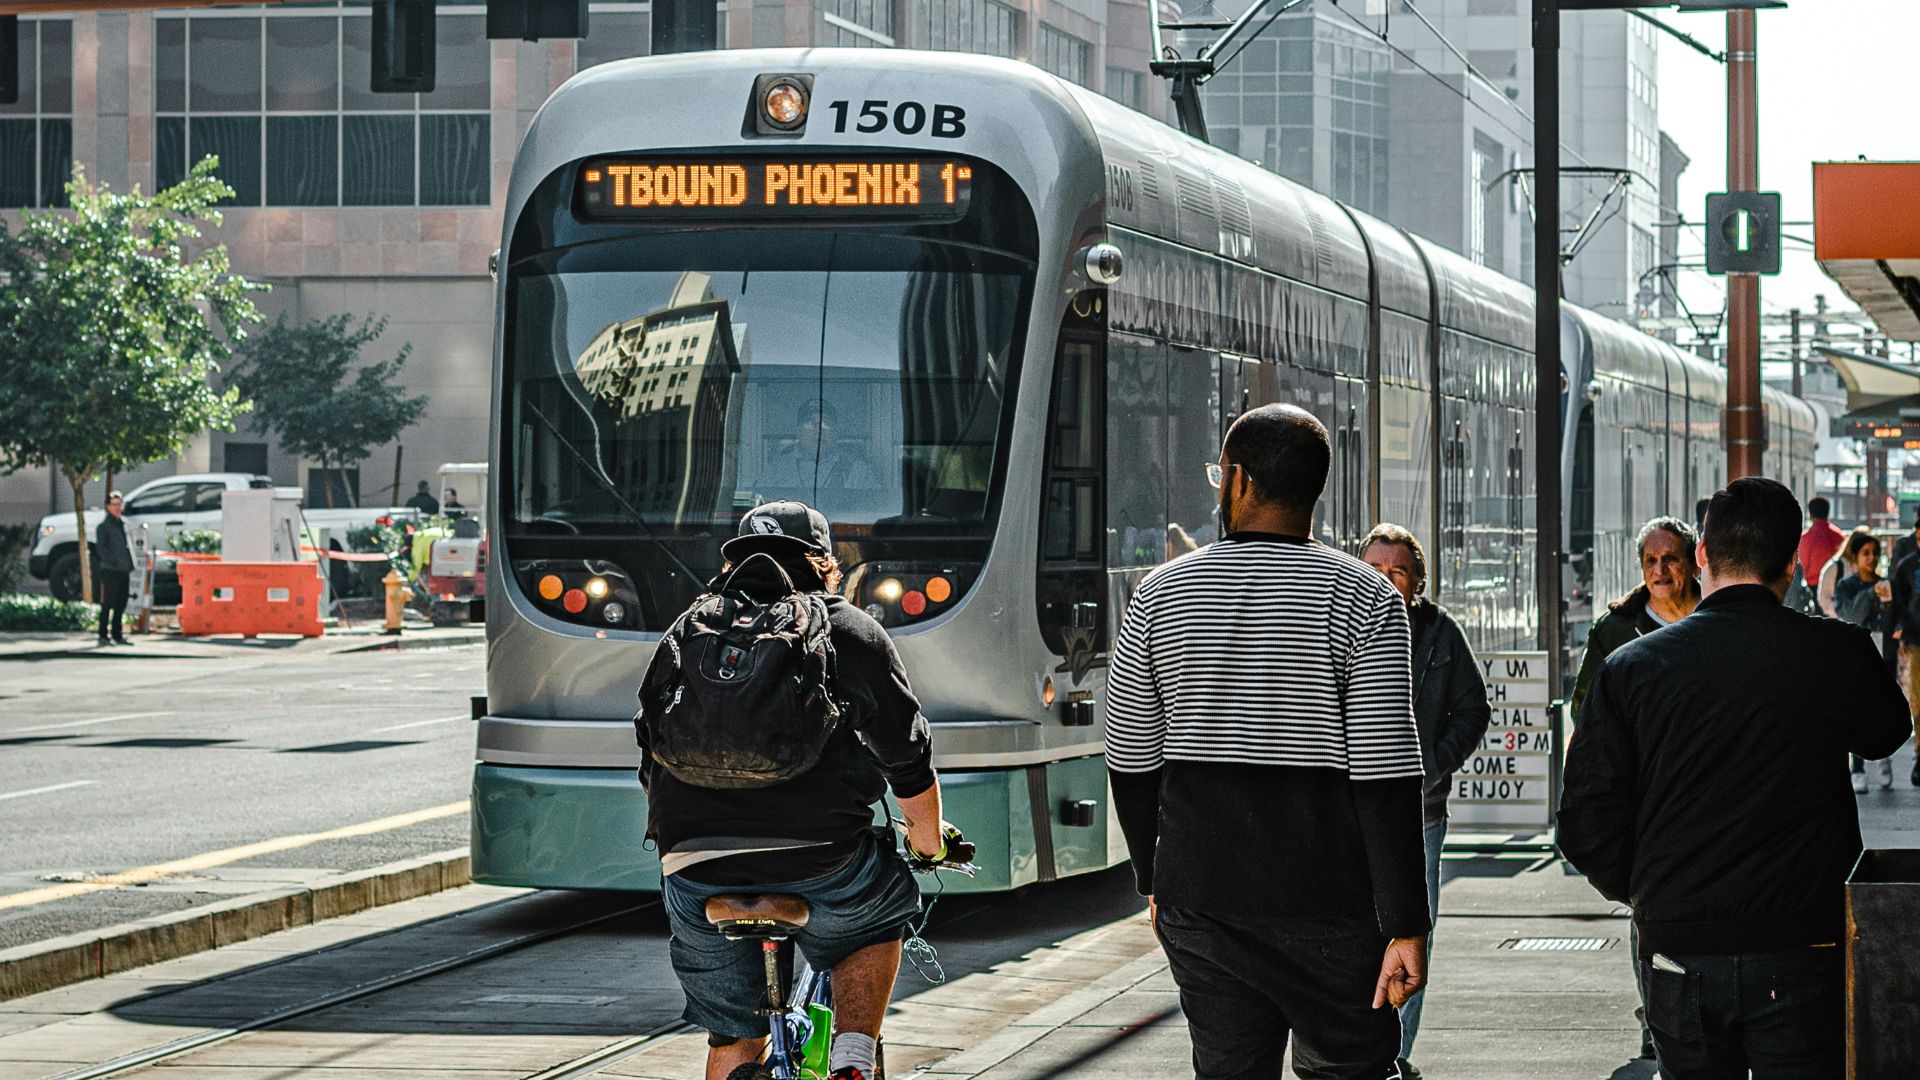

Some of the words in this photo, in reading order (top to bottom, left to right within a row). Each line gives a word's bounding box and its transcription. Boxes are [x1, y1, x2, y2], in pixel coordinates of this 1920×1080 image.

[829, 100, 966, 139] 150B
[608, 165, 747, 206] TBOUND
[765, 163, 919, 205] PHOENIX
[1108, 165, 1133, 212] 150B
[1483, 659, 1493, 677] Y
[1459, 780, 1524, 799] ENJOY
